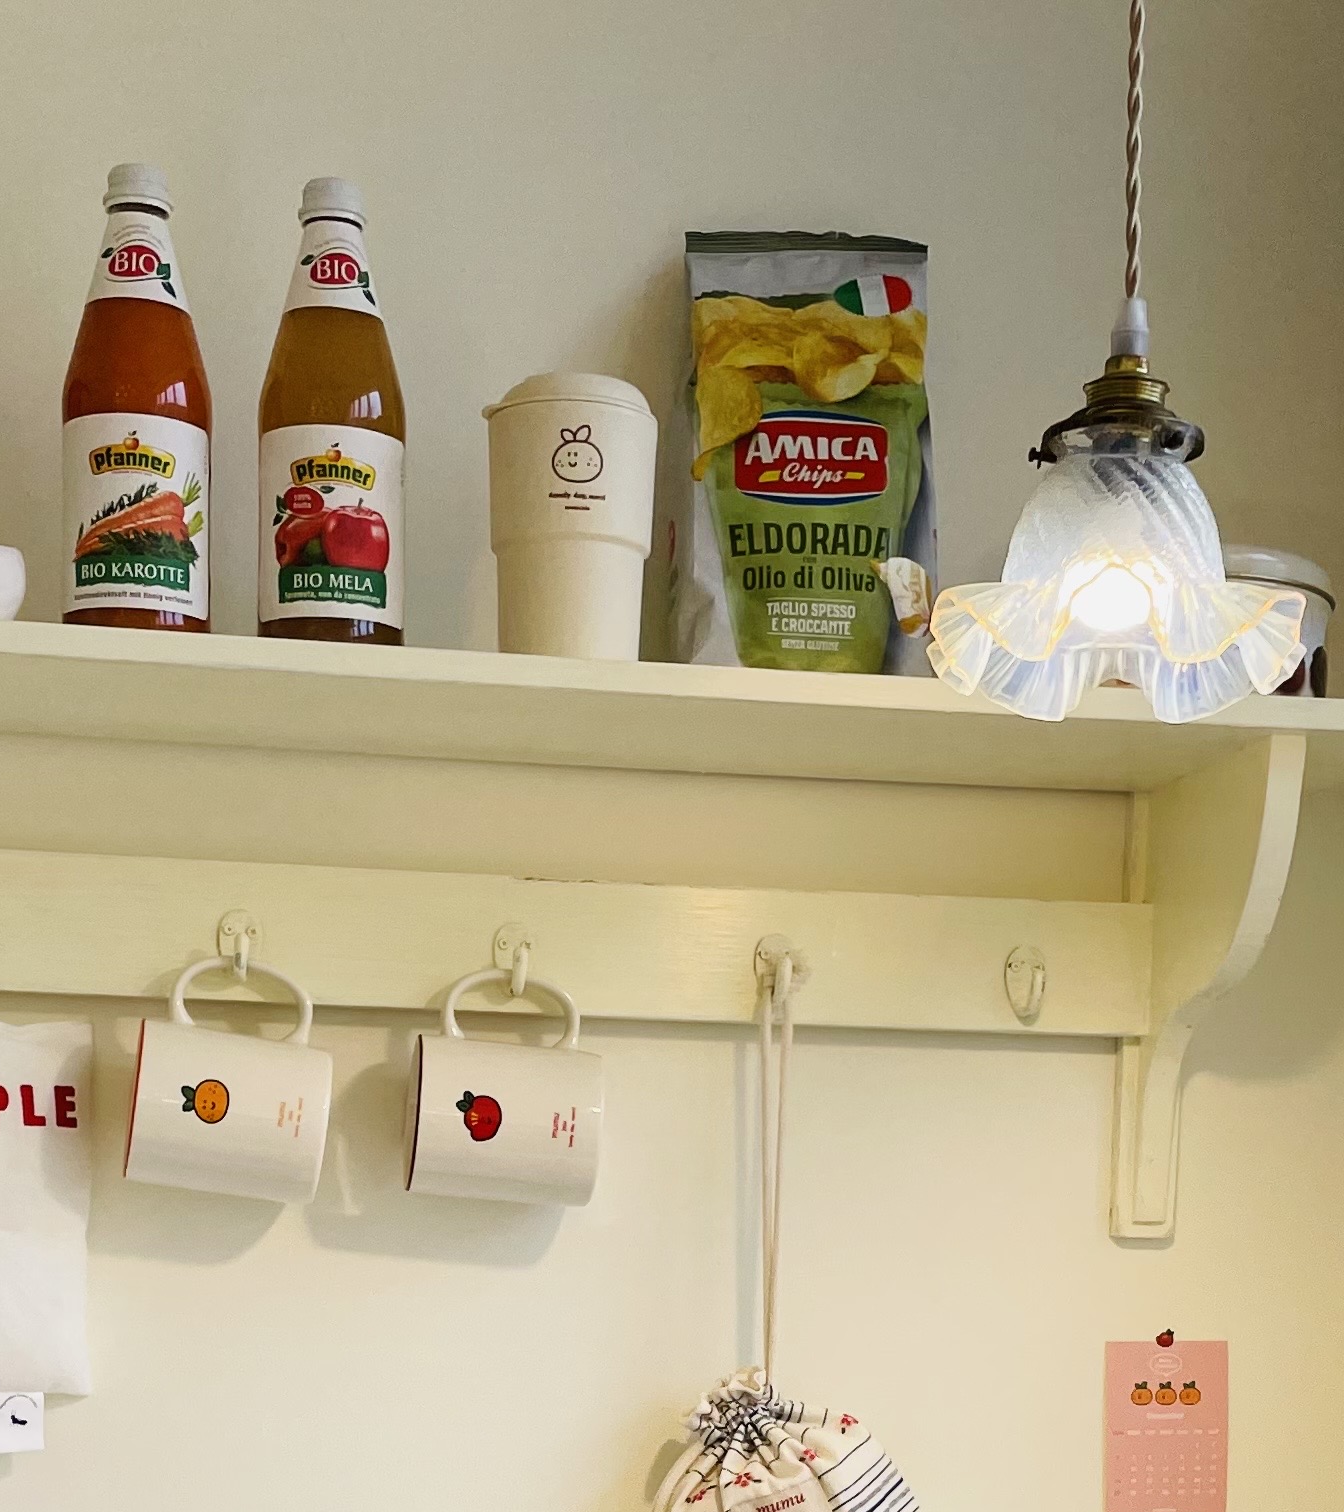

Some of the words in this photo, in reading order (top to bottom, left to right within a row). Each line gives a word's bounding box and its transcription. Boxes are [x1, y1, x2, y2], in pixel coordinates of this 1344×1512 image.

[114, 251, 158, 274] BIO
[316, 259, 359, 284] BIO
[744, 432, 879, 465] AMICA
[782, 462, 845, 489] Chips
[81, 562, 106, 580] BIO
[111, 562, 186, 584] KAROTTE
[293, 572, 323, 588] BIO
[329, 573, 374, 592] MELA
[742, 567, 786, 591] Olio
[794, 565, 813, 589] di
[821, 566, 876, 593] Oliva
[766, 602, 808, 617] TAGLIO
[810, 603, 856, 619] SPESSO
[771, 617, 779, 632] E
[781, 618, 852, 636] CROCCANTE
